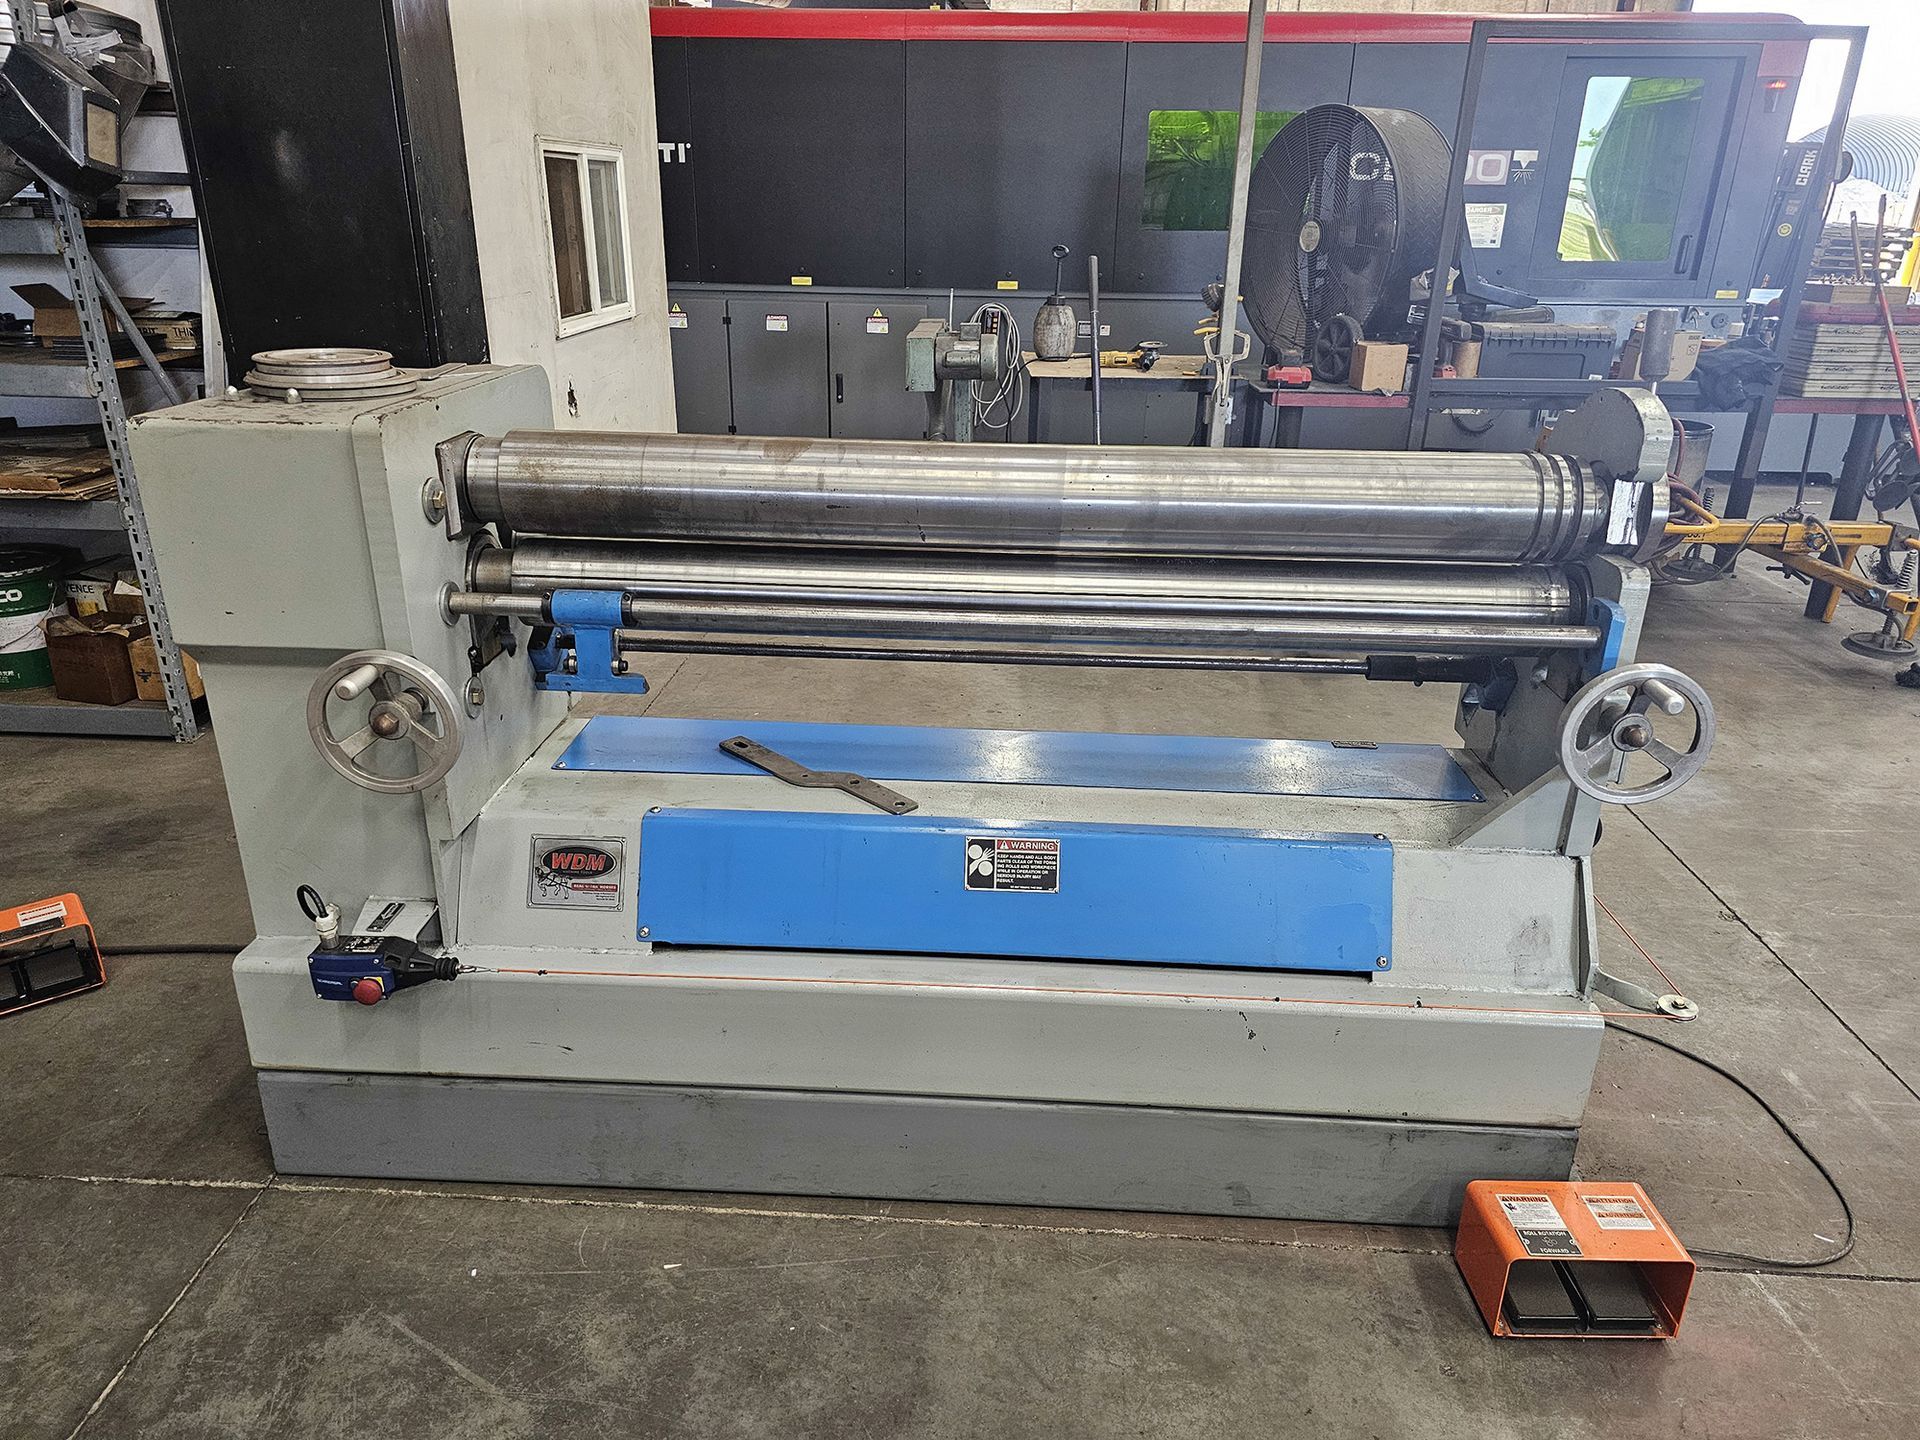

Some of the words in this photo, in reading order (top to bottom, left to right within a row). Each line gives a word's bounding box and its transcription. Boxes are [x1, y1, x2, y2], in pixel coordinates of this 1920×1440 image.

[1795, 150, 1818, 186] CLARK
[1011, 841, 1055, 850] WARNING
[551, 852, 607, 871] WDM
